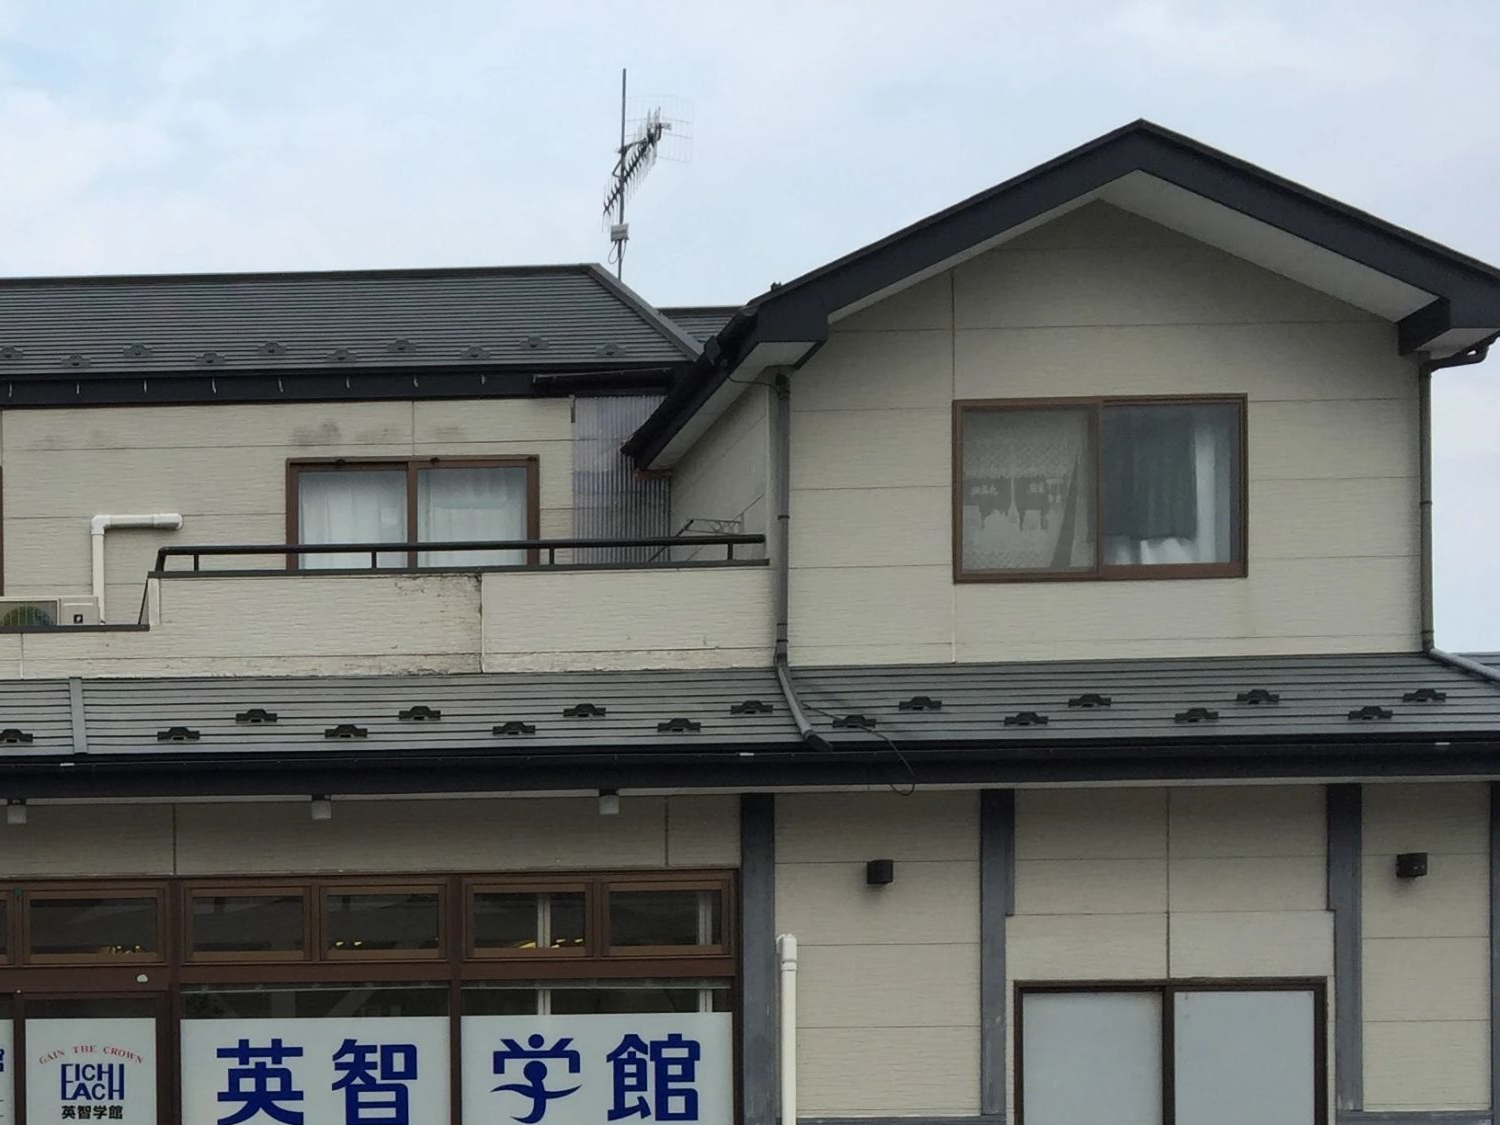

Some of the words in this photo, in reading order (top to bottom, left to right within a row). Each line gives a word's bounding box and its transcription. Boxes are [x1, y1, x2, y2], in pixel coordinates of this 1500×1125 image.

[38, 1049, 65, 1065] GAIN
[73, 1045, 98, 1054] THE
[102, 1046, 144, 1065] CROWN
[61, 1105, 124, 1120] 英智学館
